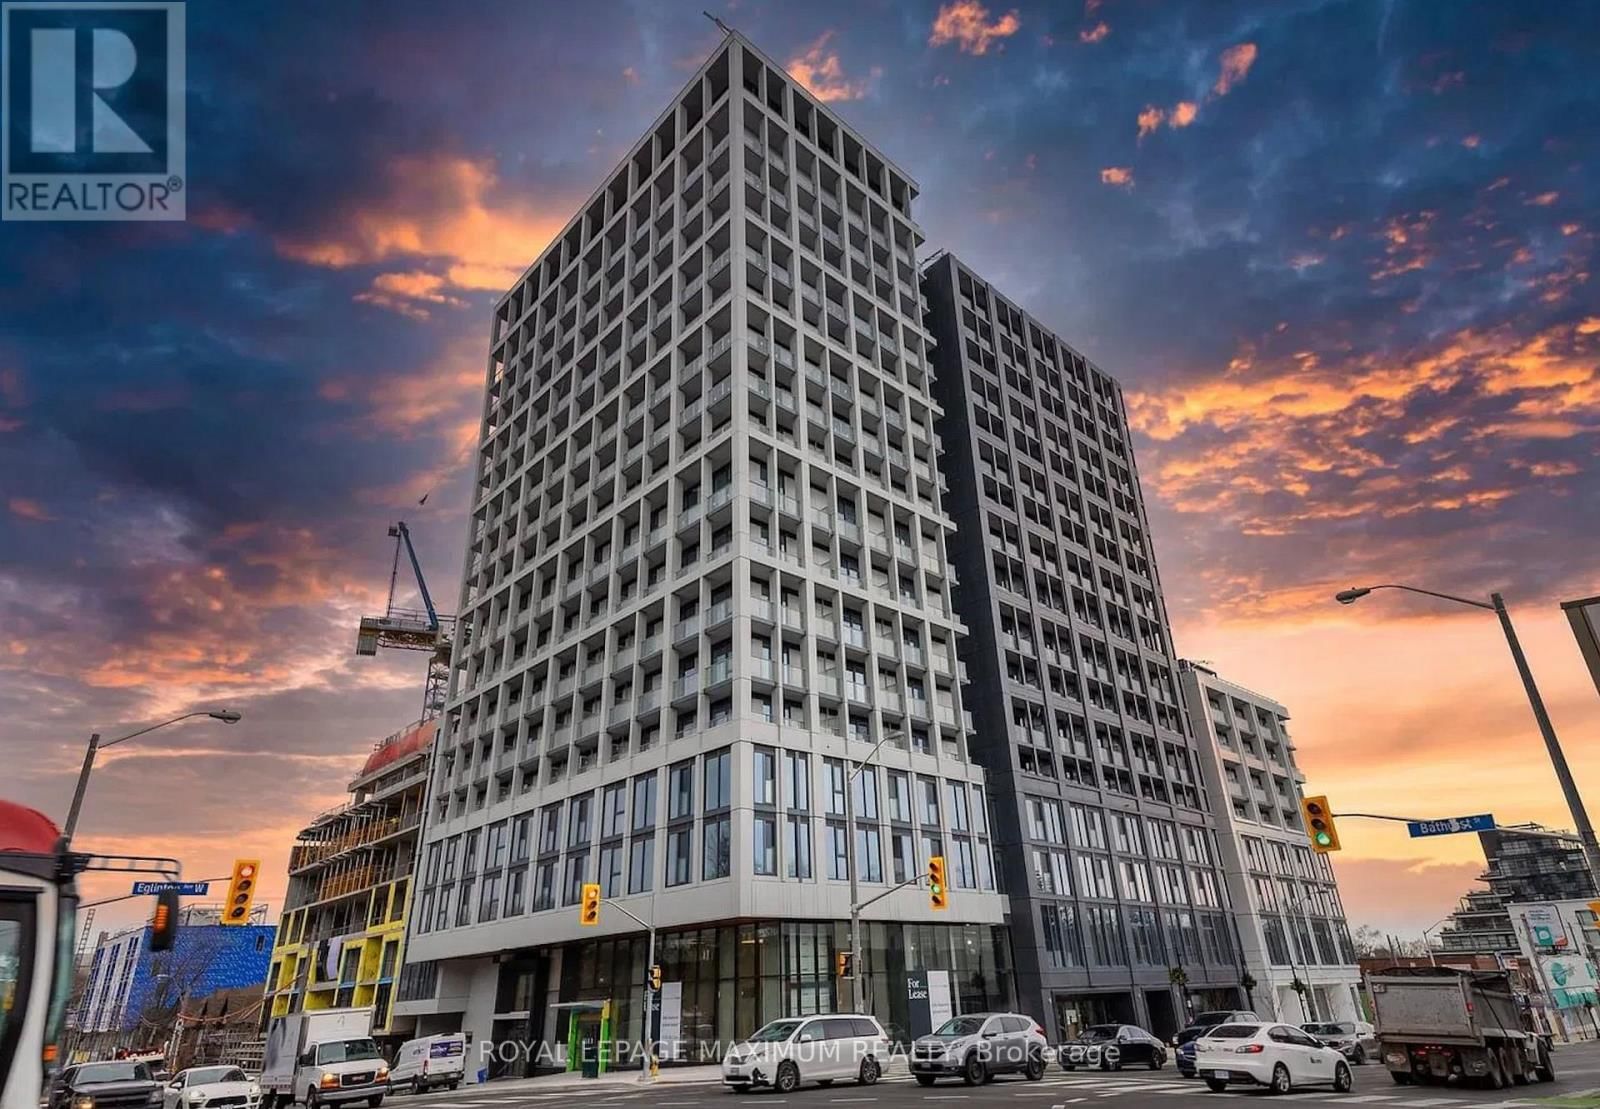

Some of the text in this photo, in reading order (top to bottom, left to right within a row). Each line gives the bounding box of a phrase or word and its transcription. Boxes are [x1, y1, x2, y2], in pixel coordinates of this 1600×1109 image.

[1420, 818, 1472, 834] Bathust
[195, 883, 205, 893] W
[908, 978, 920, 988] For
[908, 988, 928, 1000] Lease
